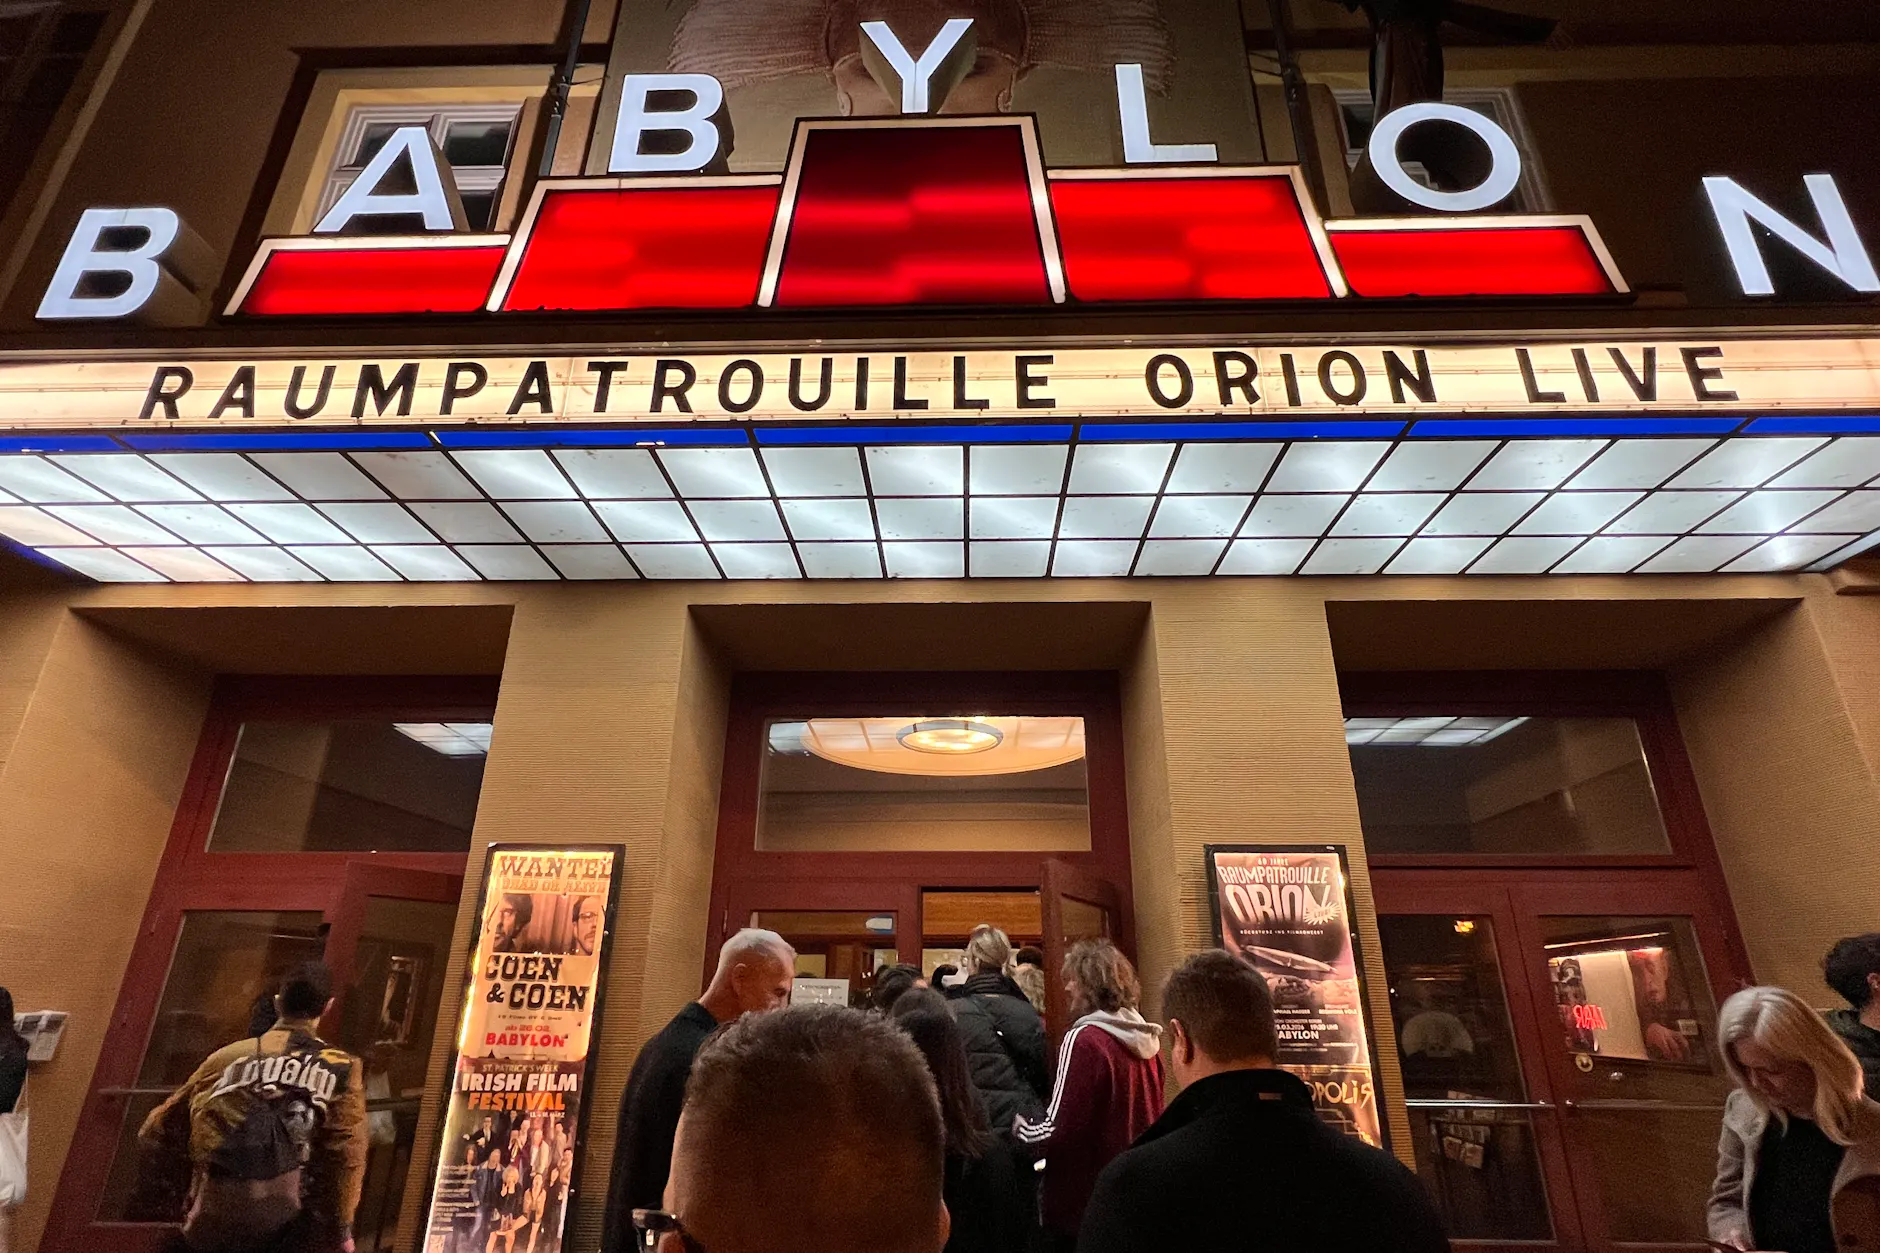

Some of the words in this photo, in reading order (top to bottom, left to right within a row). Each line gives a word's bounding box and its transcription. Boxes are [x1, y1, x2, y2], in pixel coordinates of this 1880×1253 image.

[35, 18, 1880, 320] BABYLON
[138, 353, 1056, 421] RAUMPATROUILLE
[1145, 349, 1438, 409] ORION
[1515, 346, 1739, 403] LIVE
[1216, 866, 1330, 884] RAUMPATROUILLE
[1225, 884, 1331, 924] ORION
[485, 955, 562, 982] COEN
[486, 982, 506, 1003] &
[508, 983, 589, 1012] COEN
[485, 1032, 565, 1048] BABYLON
[1277, 1031, 1319, 1040] ABYLON
[495, 1064, 534, 1072] PATRICK'S
[536, 1063, 559, 1072] WEEK
[461, 1073, 522, 1091] IRISH
[526, 1073, 578, 1091] FILM
[468, 1091, 566, 1111] FESTIVAL
